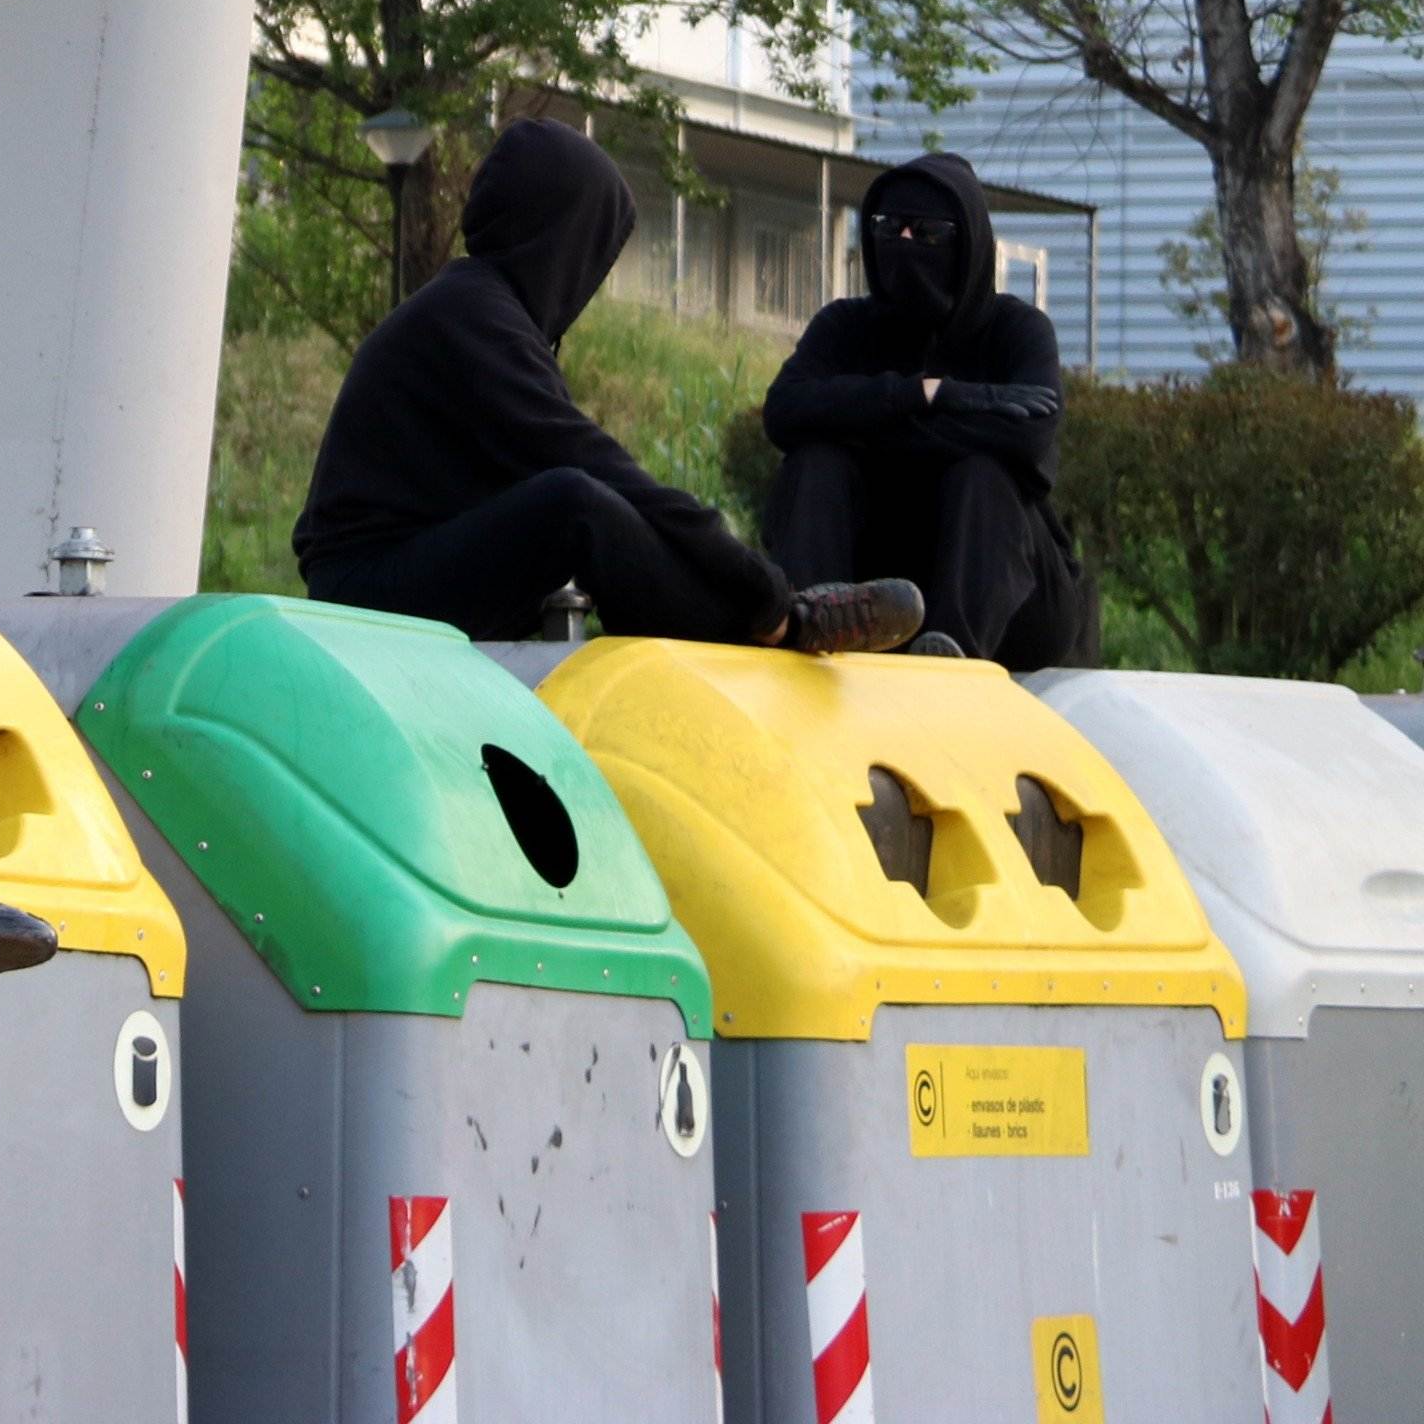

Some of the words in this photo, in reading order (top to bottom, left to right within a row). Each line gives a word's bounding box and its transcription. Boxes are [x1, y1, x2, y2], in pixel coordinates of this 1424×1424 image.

[971, 1100, 1004, 1113] envasos
[1006, 1097, 1017, 1113] de
[1007, 1122, 1028, 1138] brics
